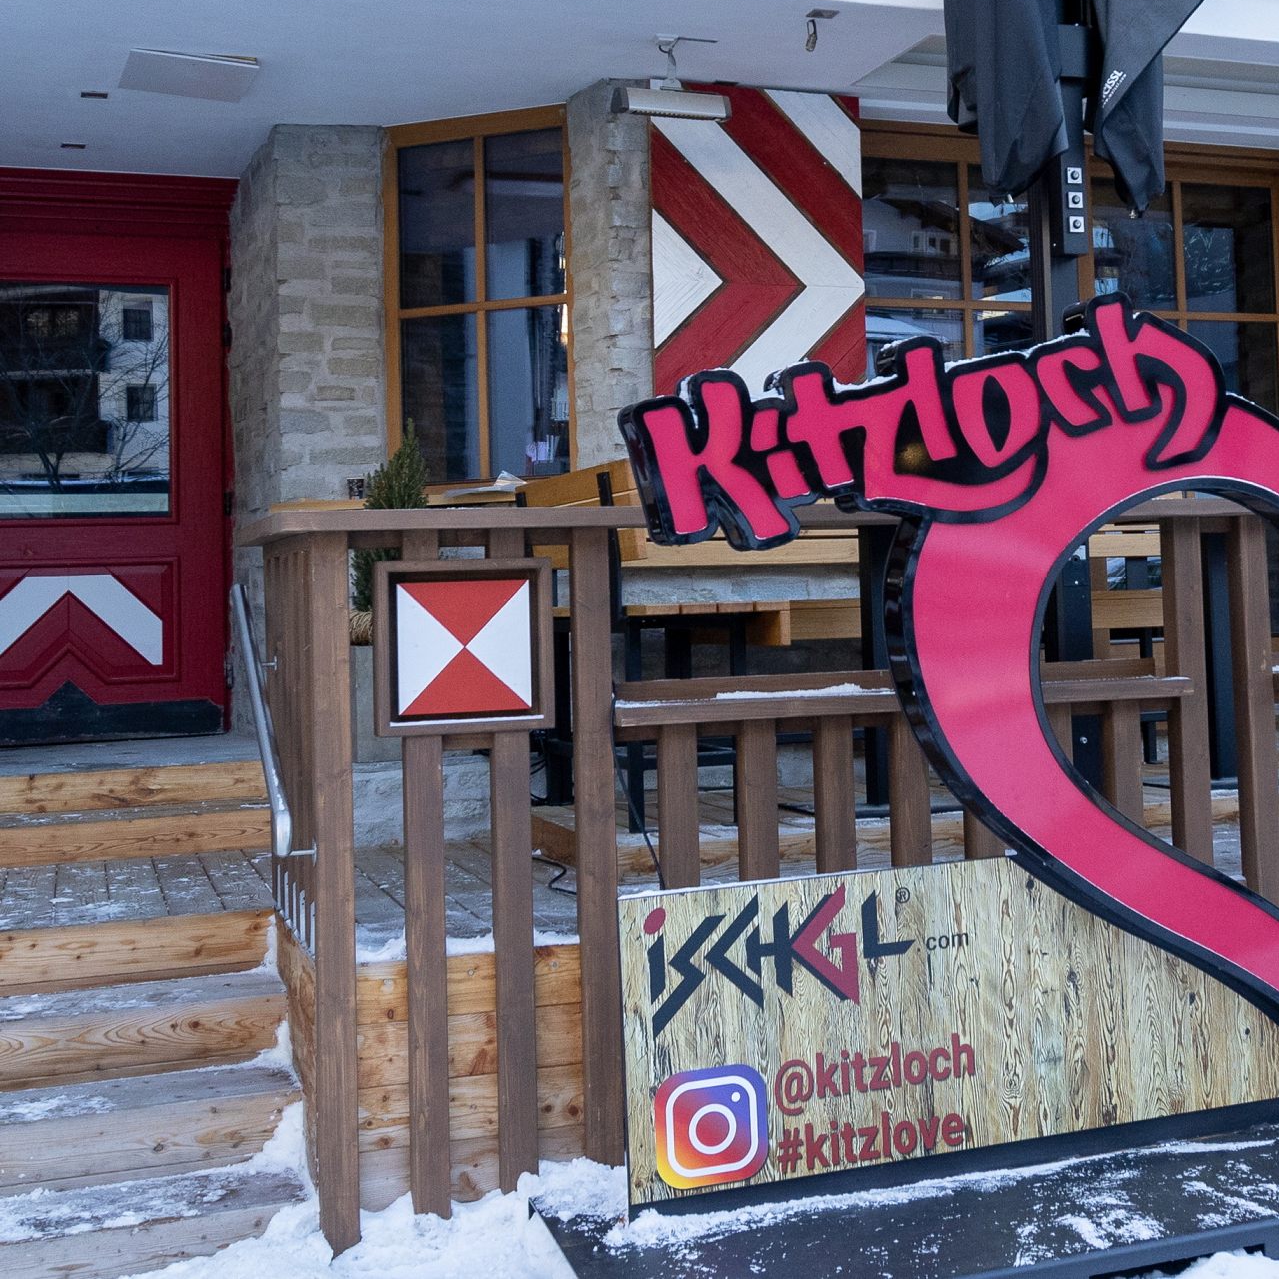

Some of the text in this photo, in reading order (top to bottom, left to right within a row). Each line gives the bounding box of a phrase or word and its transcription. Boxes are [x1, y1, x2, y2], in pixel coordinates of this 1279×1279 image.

[632, 296, 1222, 545] Kitzloch
[774, 1032, 976, 1116] @kitzloch
[777, 1112, 965, 1173] #kitzlove
